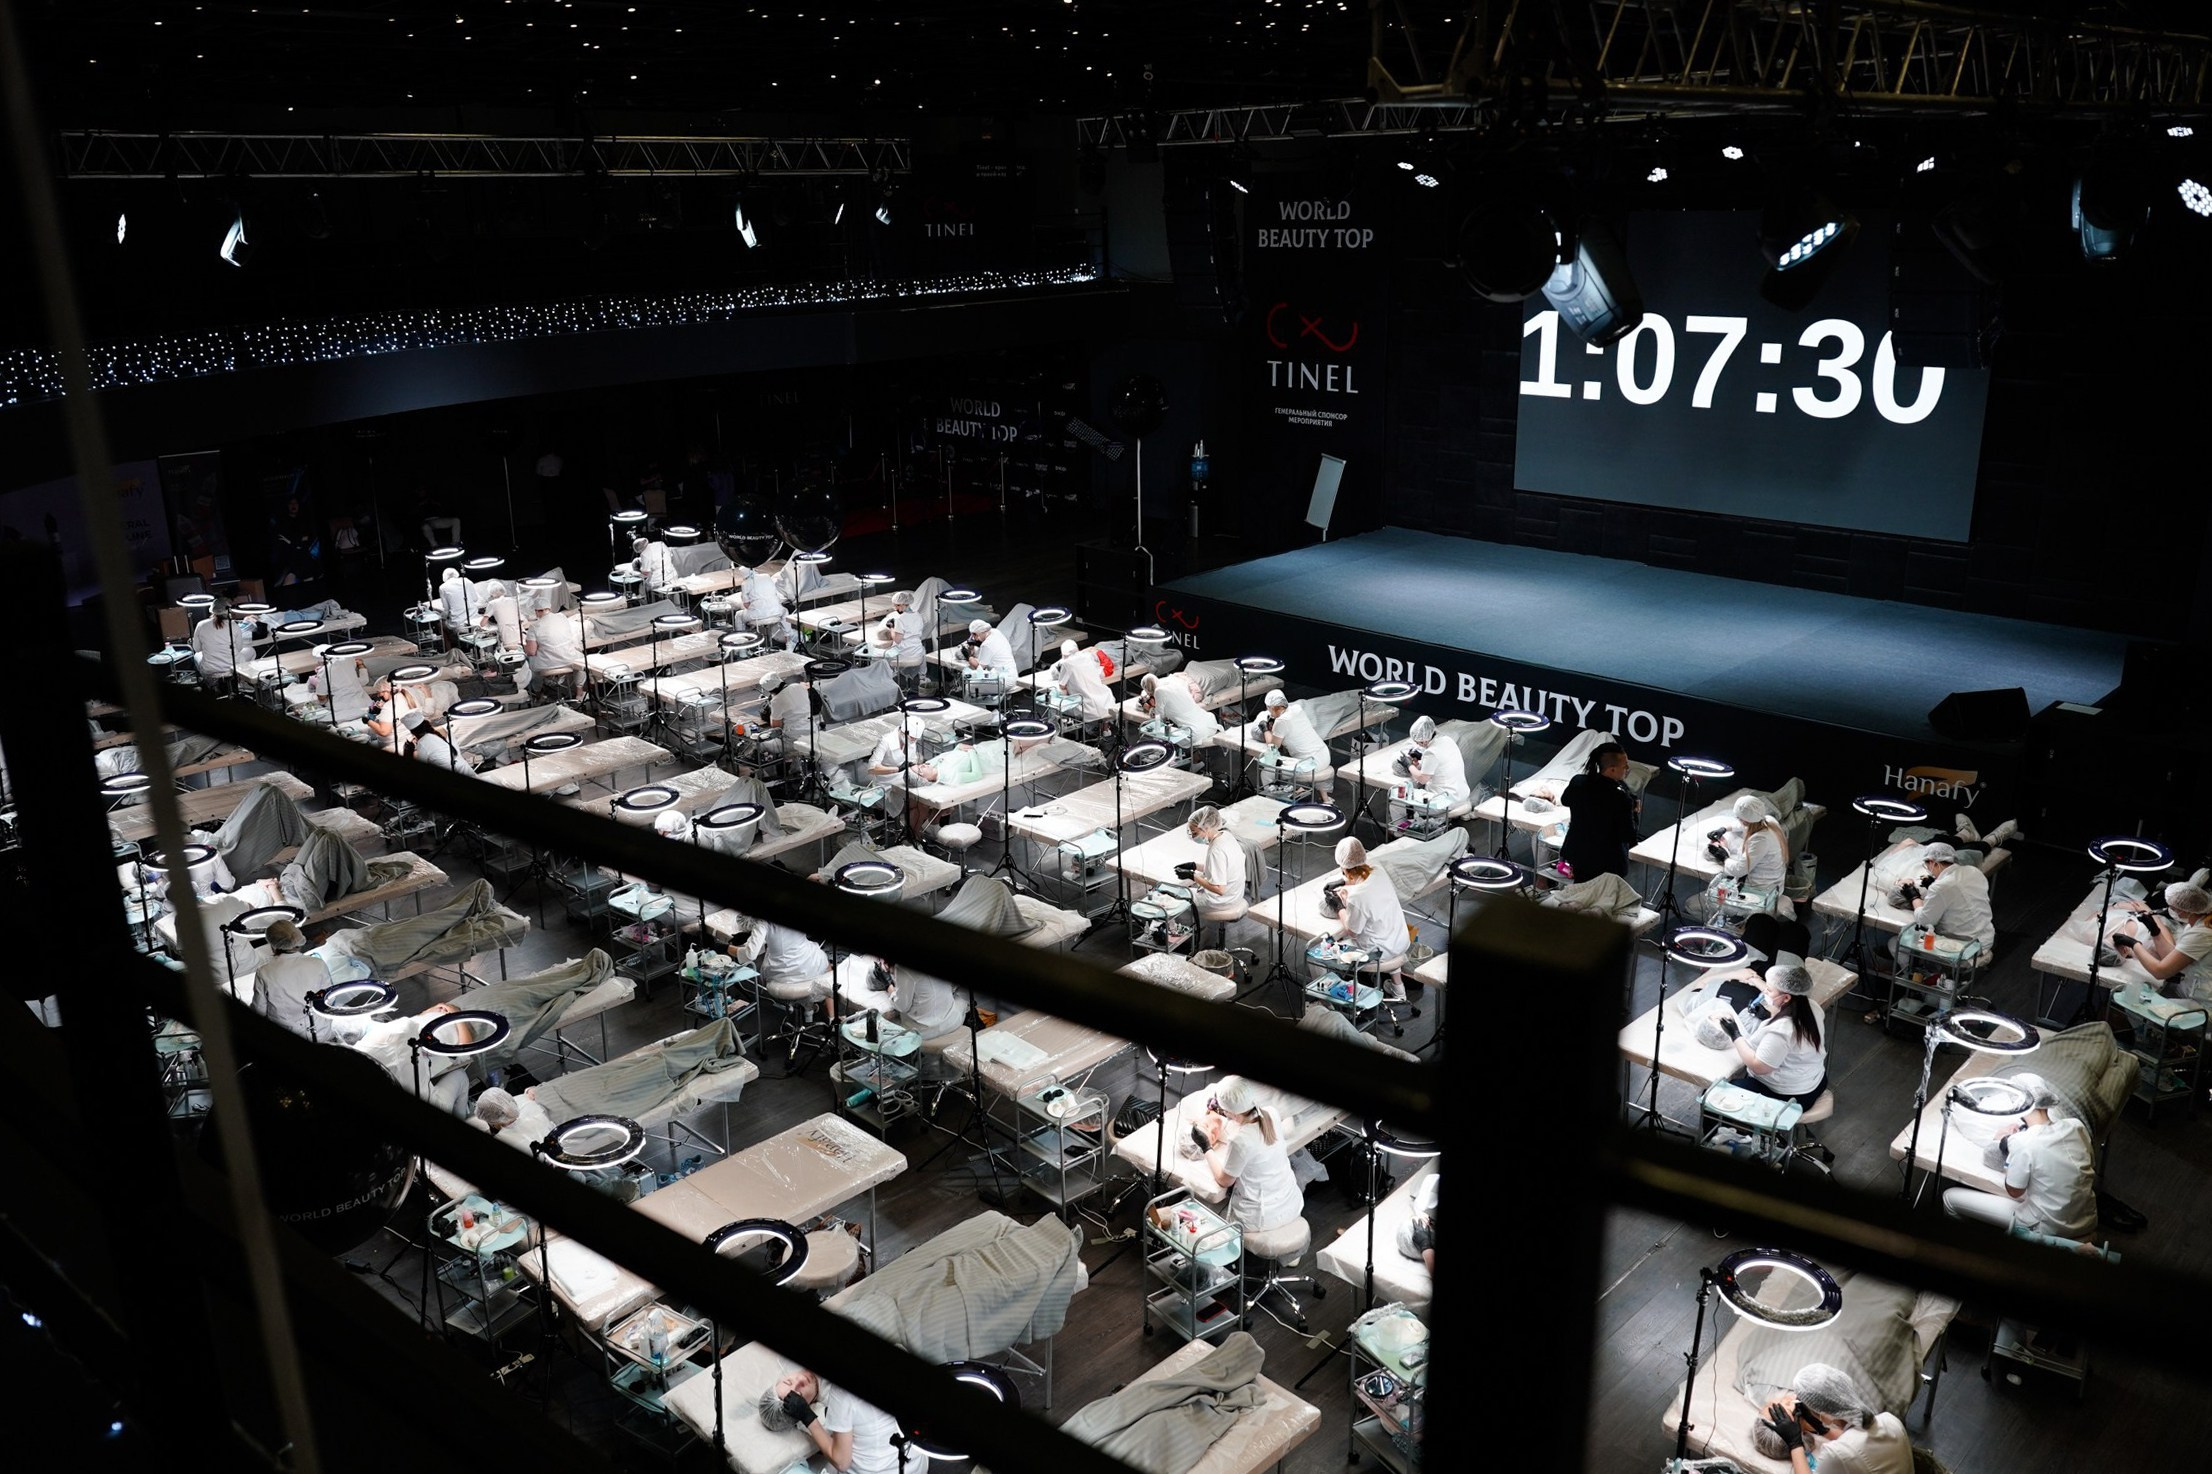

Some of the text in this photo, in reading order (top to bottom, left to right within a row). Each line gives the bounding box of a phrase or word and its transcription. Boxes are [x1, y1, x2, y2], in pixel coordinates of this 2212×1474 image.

[1279, 200, 1351, 220] WORLD
[1258, 228, 1374, 248] BEAUTY TOP
[1266, 360, 1359, 394] TINEL
[950, 397, 1001, 418] WORLD
[1317, 411, 1348, 421] СПОНСОР
[1171, 630, 1201, 650] NEL
[1327, 644, 1685, 748] WORLD BEAUTY TOP
[1883, 764, 1981, 809] Hanafy
[336, 1183, 385, 1214] BEAUTY
[387, 1167, 406, 1188] TOP
